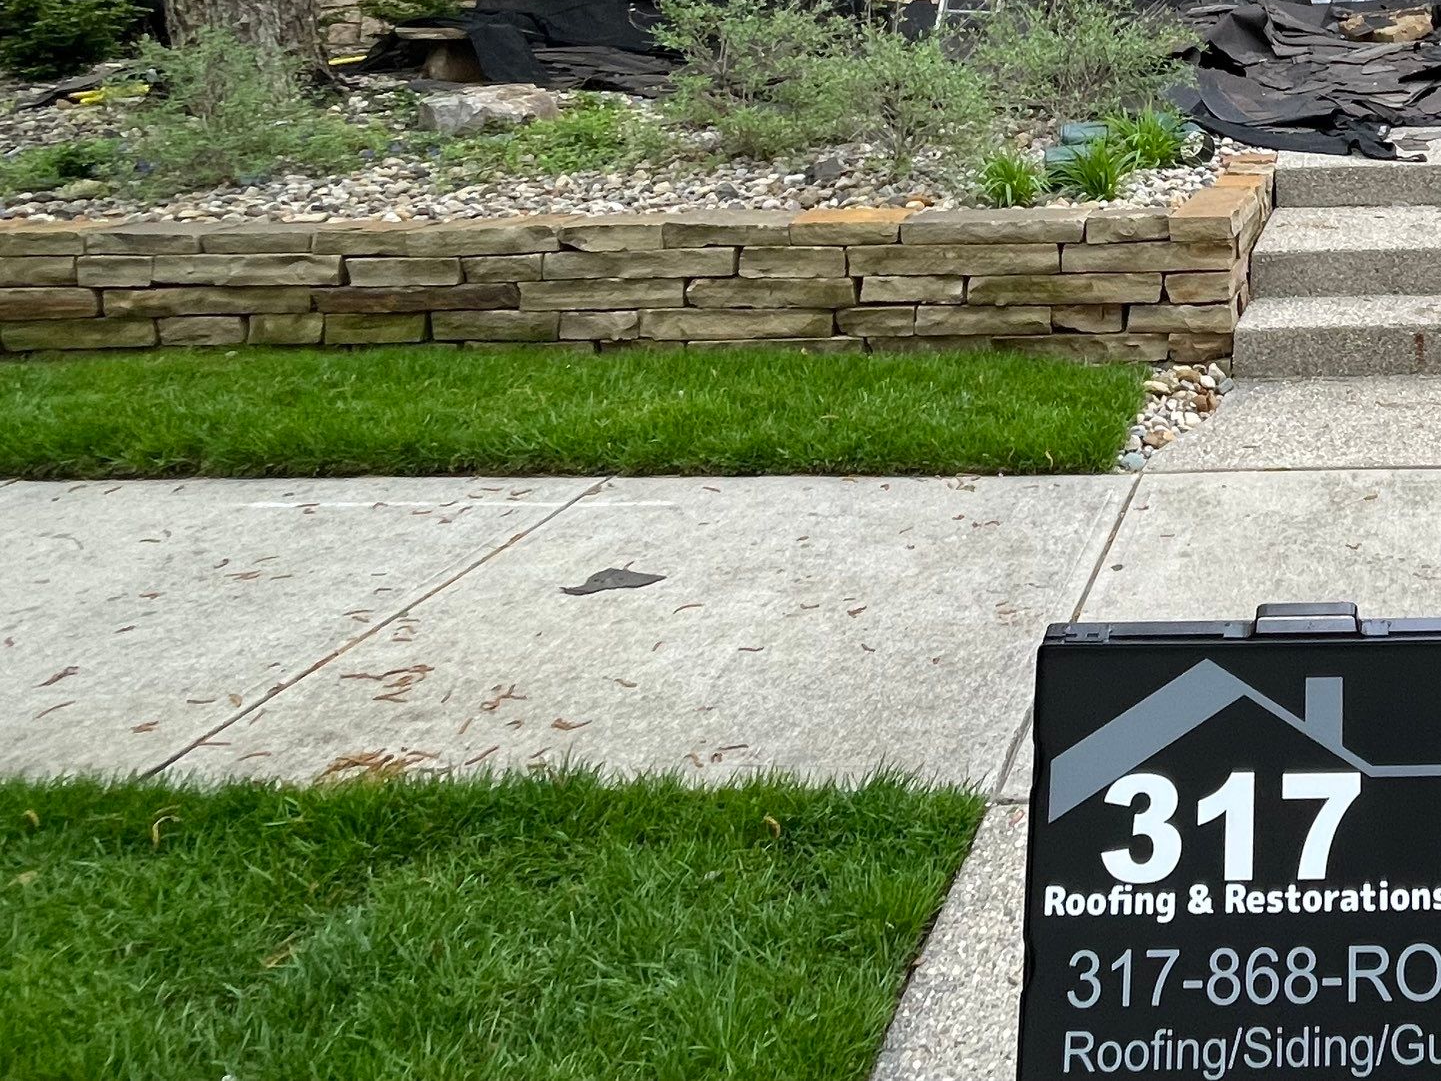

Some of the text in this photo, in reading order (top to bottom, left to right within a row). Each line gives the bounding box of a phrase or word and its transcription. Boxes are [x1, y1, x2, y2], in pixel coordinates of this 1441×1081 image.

[1100, 771, 1362, 884] 317
[1043, 884, 1176, 923] Roofing
[1187, 884, 1214, 915] &
